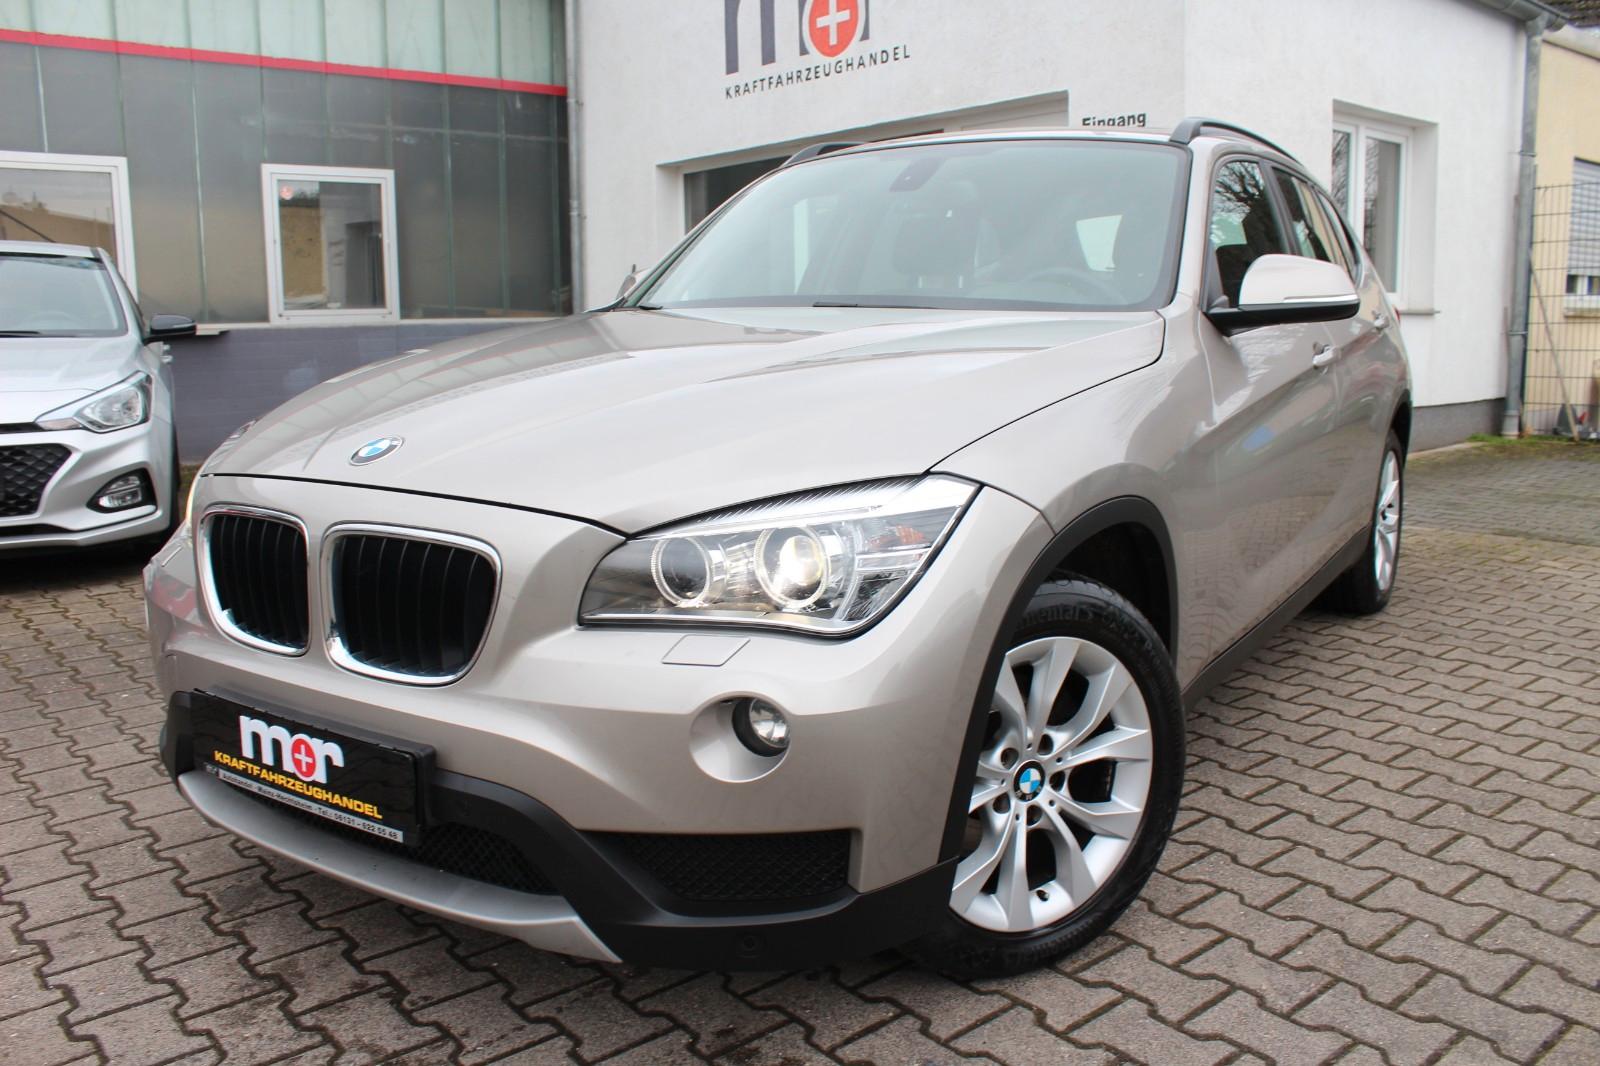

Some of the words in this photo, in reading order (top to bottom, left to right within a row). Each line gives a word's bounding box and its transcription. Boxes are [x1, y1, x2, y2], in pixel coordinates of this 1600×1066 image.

[725, 44, 911, 99] KRAFTFAHRZEUGHANDEL
[1082, 112, 1147, 128] Eingang
[213, 750, 383, 819] KRAFTFAHRZEUGHANDEL
